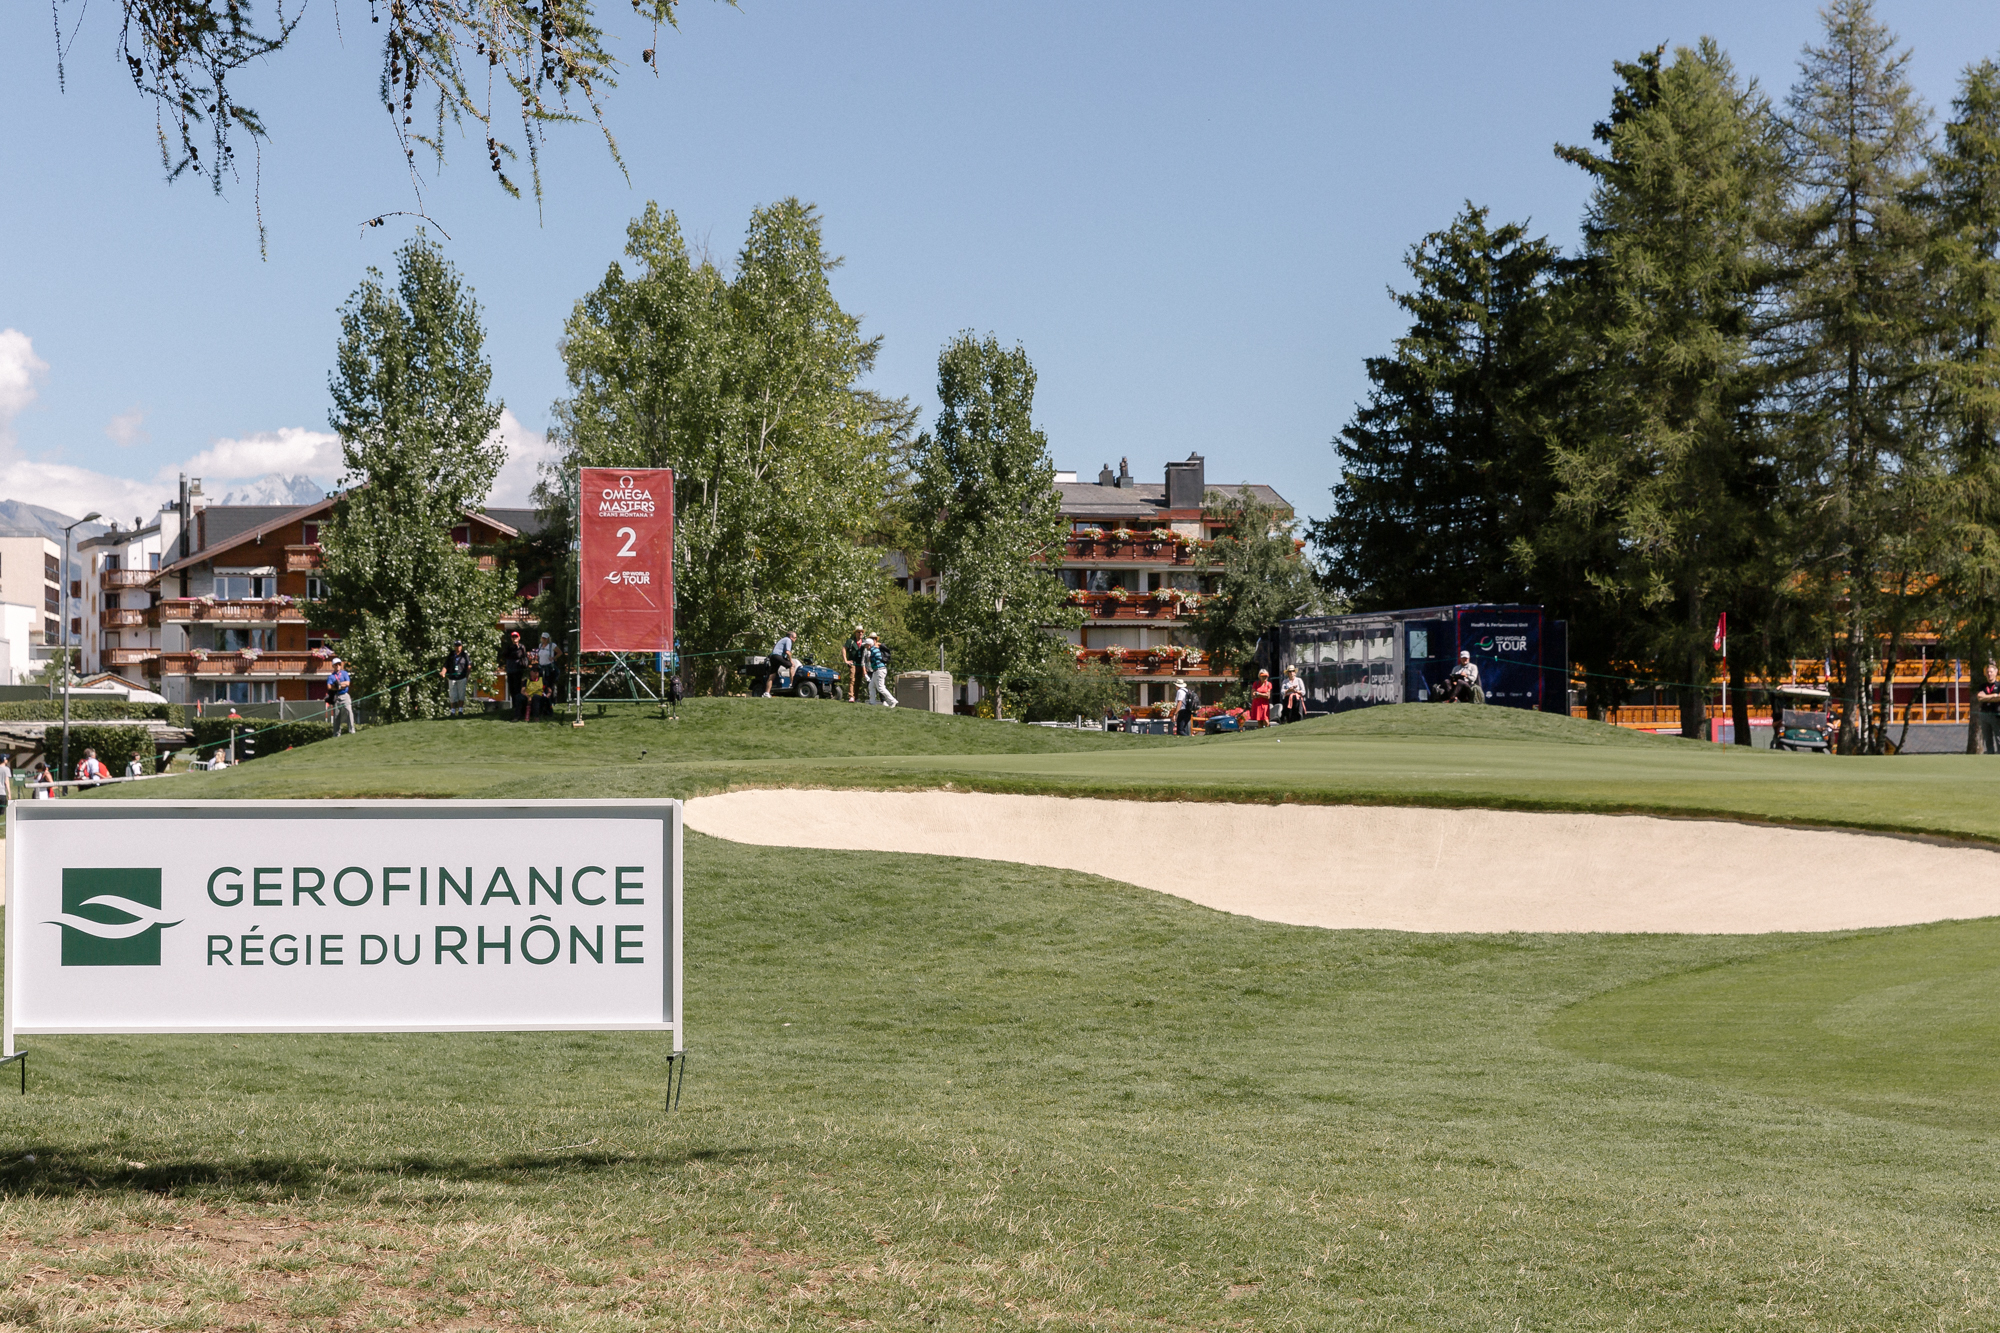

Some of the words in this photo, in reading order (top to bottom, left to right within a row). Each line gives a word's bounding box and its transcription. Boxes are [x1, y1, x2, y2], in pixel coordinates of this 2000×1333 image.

[602, 488, 652, 500] OMEGA
[599, 500, 655, 512] MASTERS
[616, 526, 637, 557] 2
[622, 575, 650, 585] TOUR
[1496, 641, 1527, 652] TOUR
[1371, 684, 1396, 704] TOUR
[207, 865, 645, 907] GEROFINANCE
[207, 924, 344, 966] RÉGIE
[360, 934, 421, 966] DU
[435, 914, 644, 966] RHÔNE
